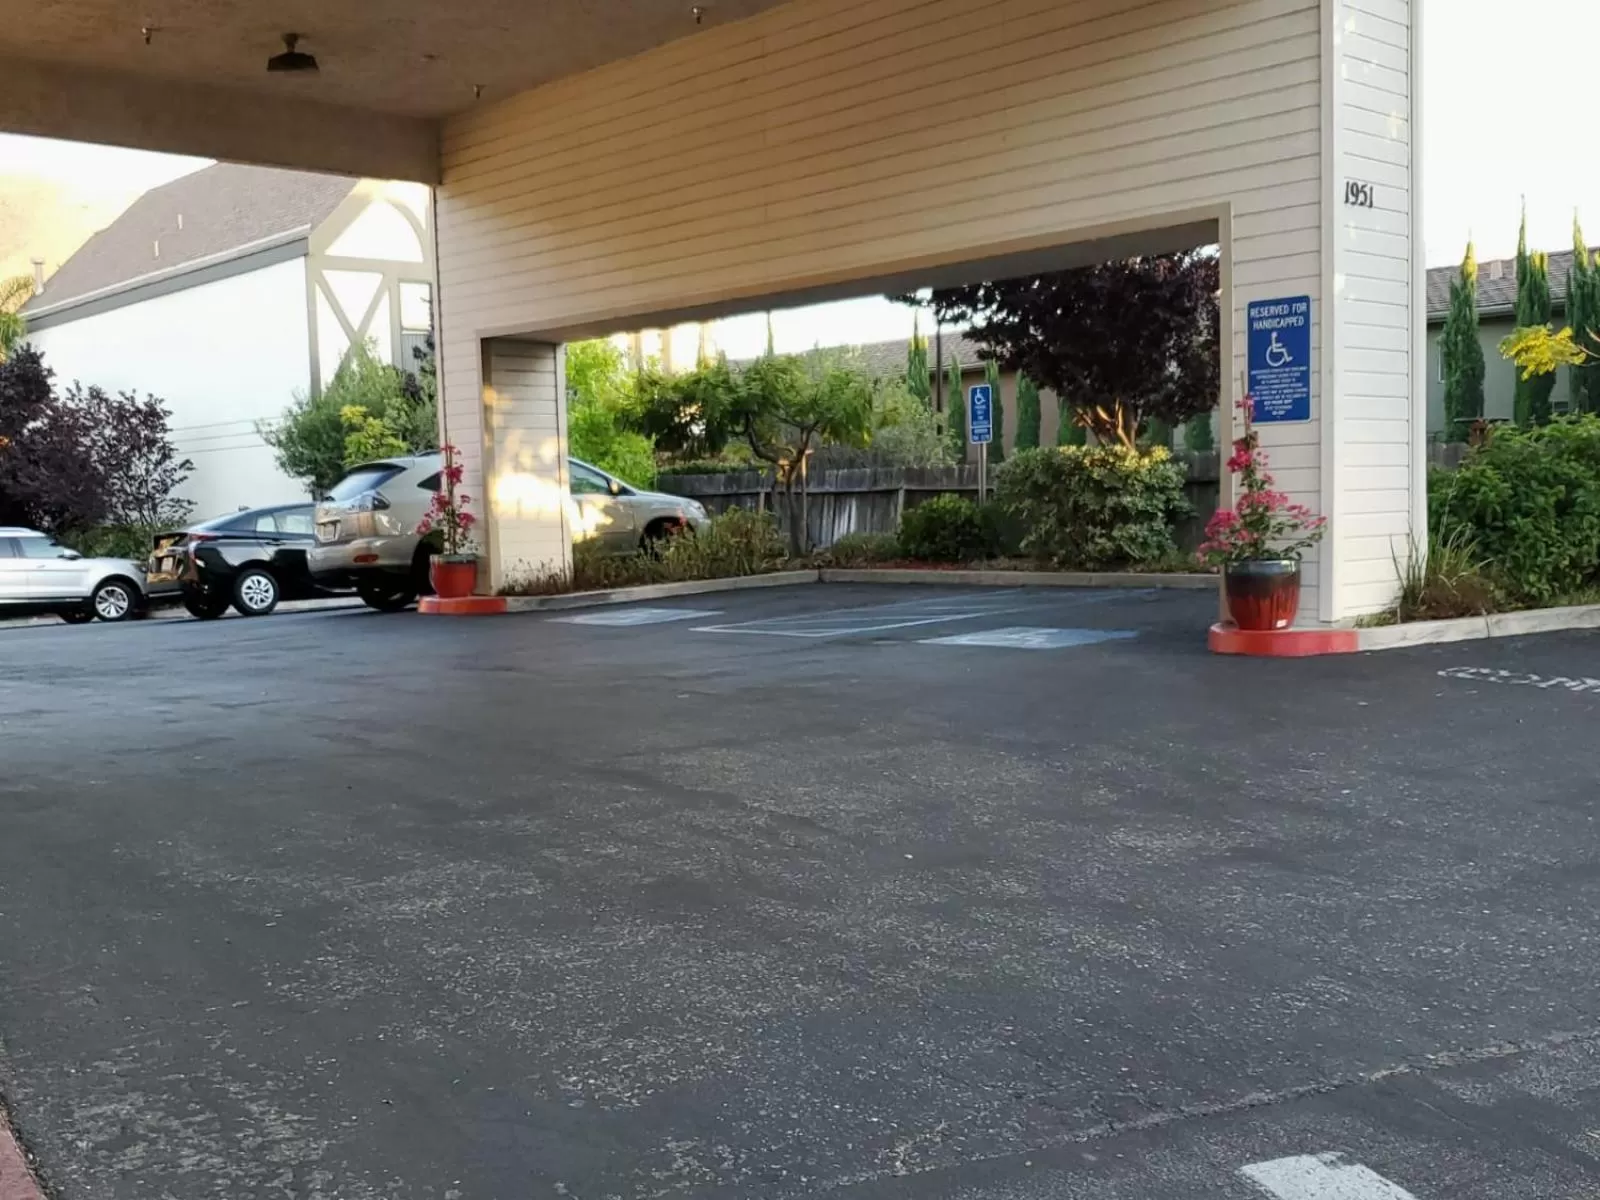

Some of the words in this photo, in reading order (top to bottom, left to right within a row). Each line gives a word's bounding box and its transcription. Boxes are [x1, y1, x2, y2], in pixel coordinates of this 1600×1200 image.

[1344, 181, 1373, 208] 1951
[1250, 304, 1290, 318] RESERVED
[1292, 302, 1307, 314] FOR
[1253, 316, 1304, 330] HANDICAPPED
